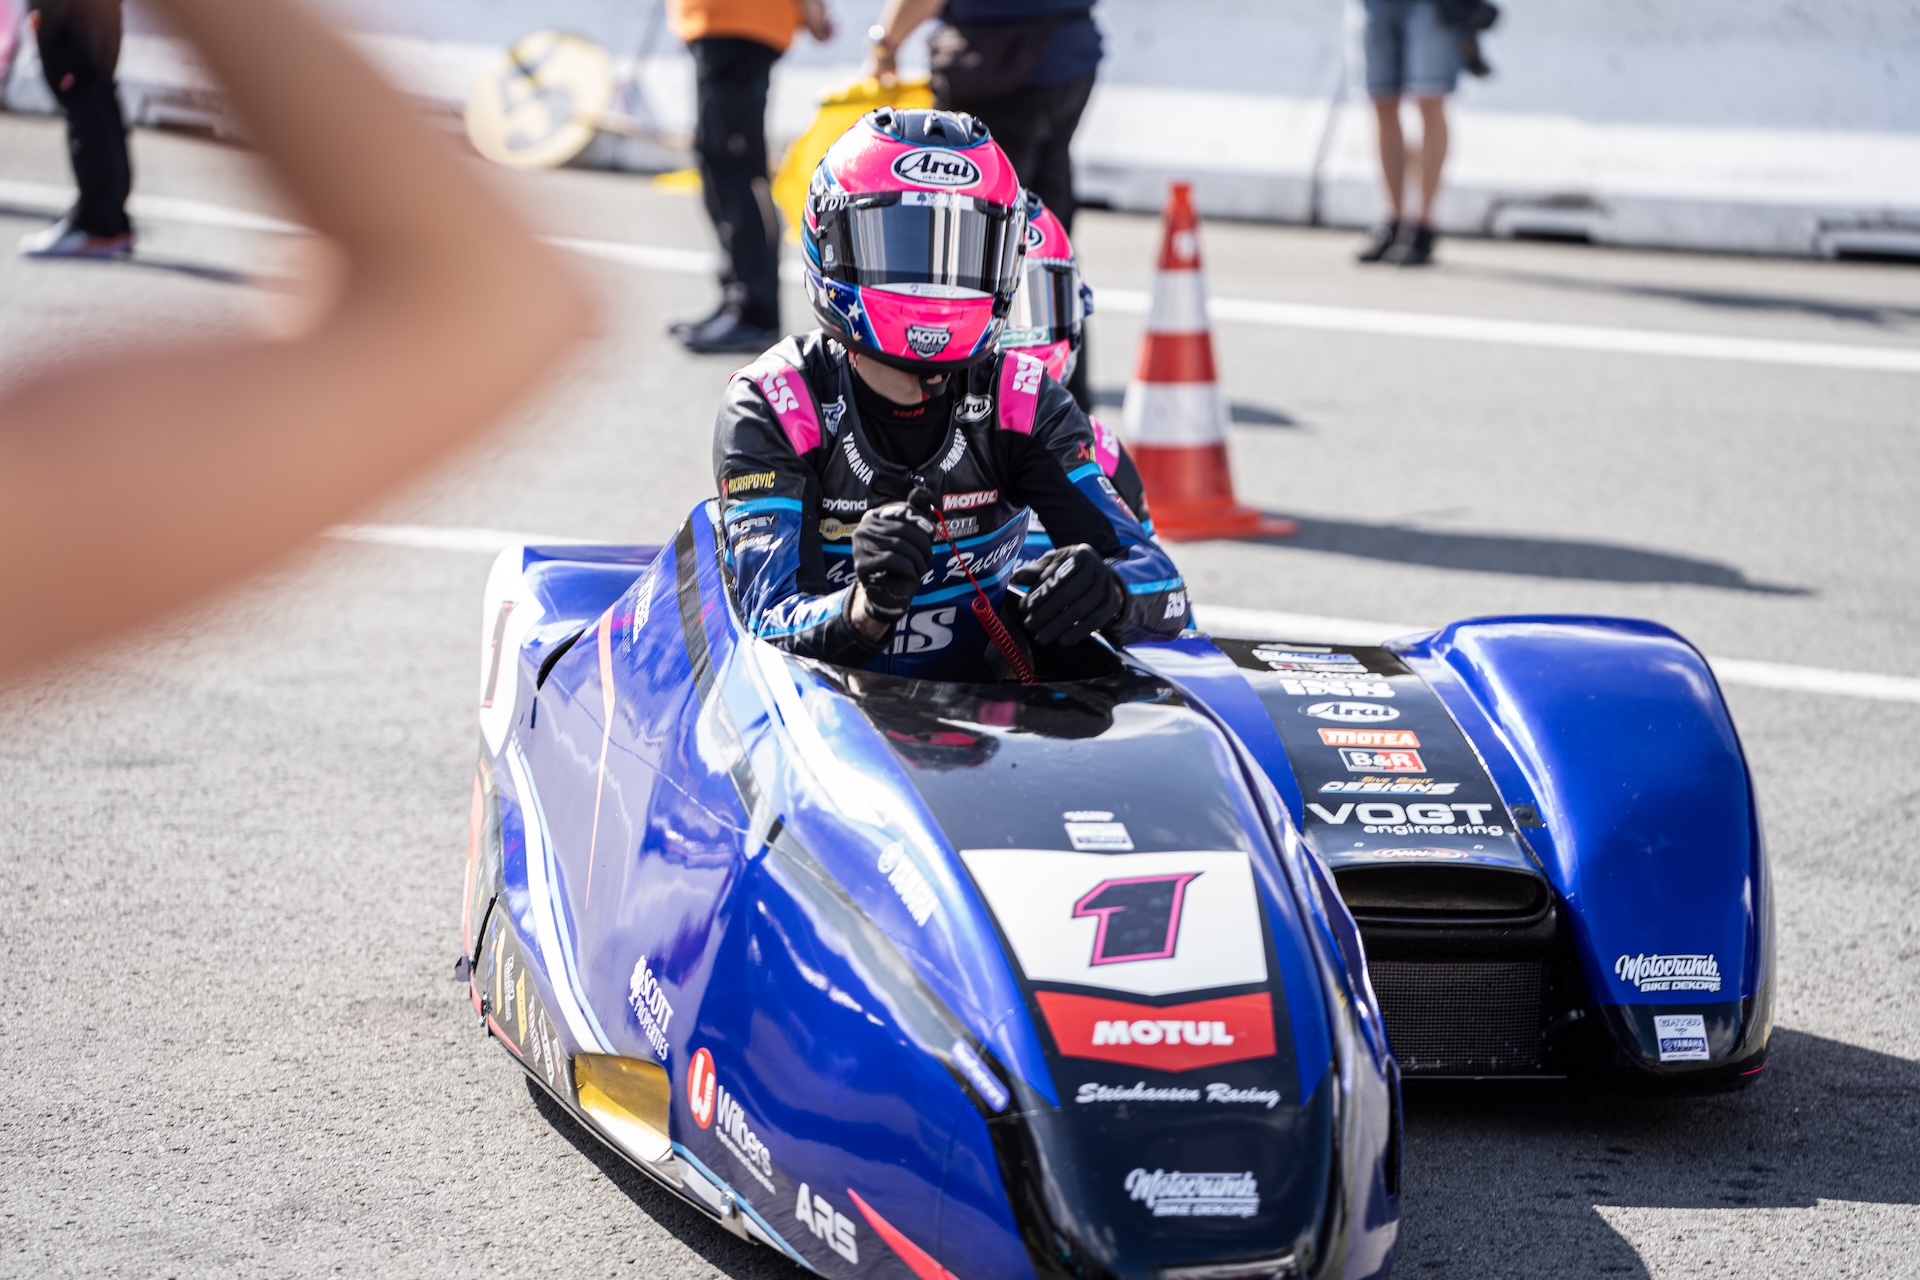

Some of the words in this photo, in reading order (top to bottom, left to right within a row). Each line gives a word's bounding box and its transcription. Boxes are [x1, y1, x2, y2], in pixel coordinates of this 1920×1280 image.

[902, 153, 970, 178] Arai
[907, 329, 951, 345] MOTO
[842, 431, 875, 486] YAMAHA
[943, 490, 996, 510] MOTUL
[942, 534, 1020, 583] Racing
[1308, 703, 1394, 716] Arai
[1325, 730, 1415, 746] MOTEA
[1350, 752, 1414, 767] B&R
[1319, 781, 1461, 795] DESIGNS
[1306, 803, 1492, 825] VOGT
[1363, 823, 1504, 836] engineering
[1072, 871, 1205, 967] 1
[1640, 982, 1671, 992] BIKE
[641, 968, 674, 1034] SCOTT
[1092, 1019, 1235, 1046] MOTUL
[1205, 1082, 1281, 1109] Racing
[717, 1085, 773, 1176] Wilbers
[795, 1183, 858, 1264] ARS
